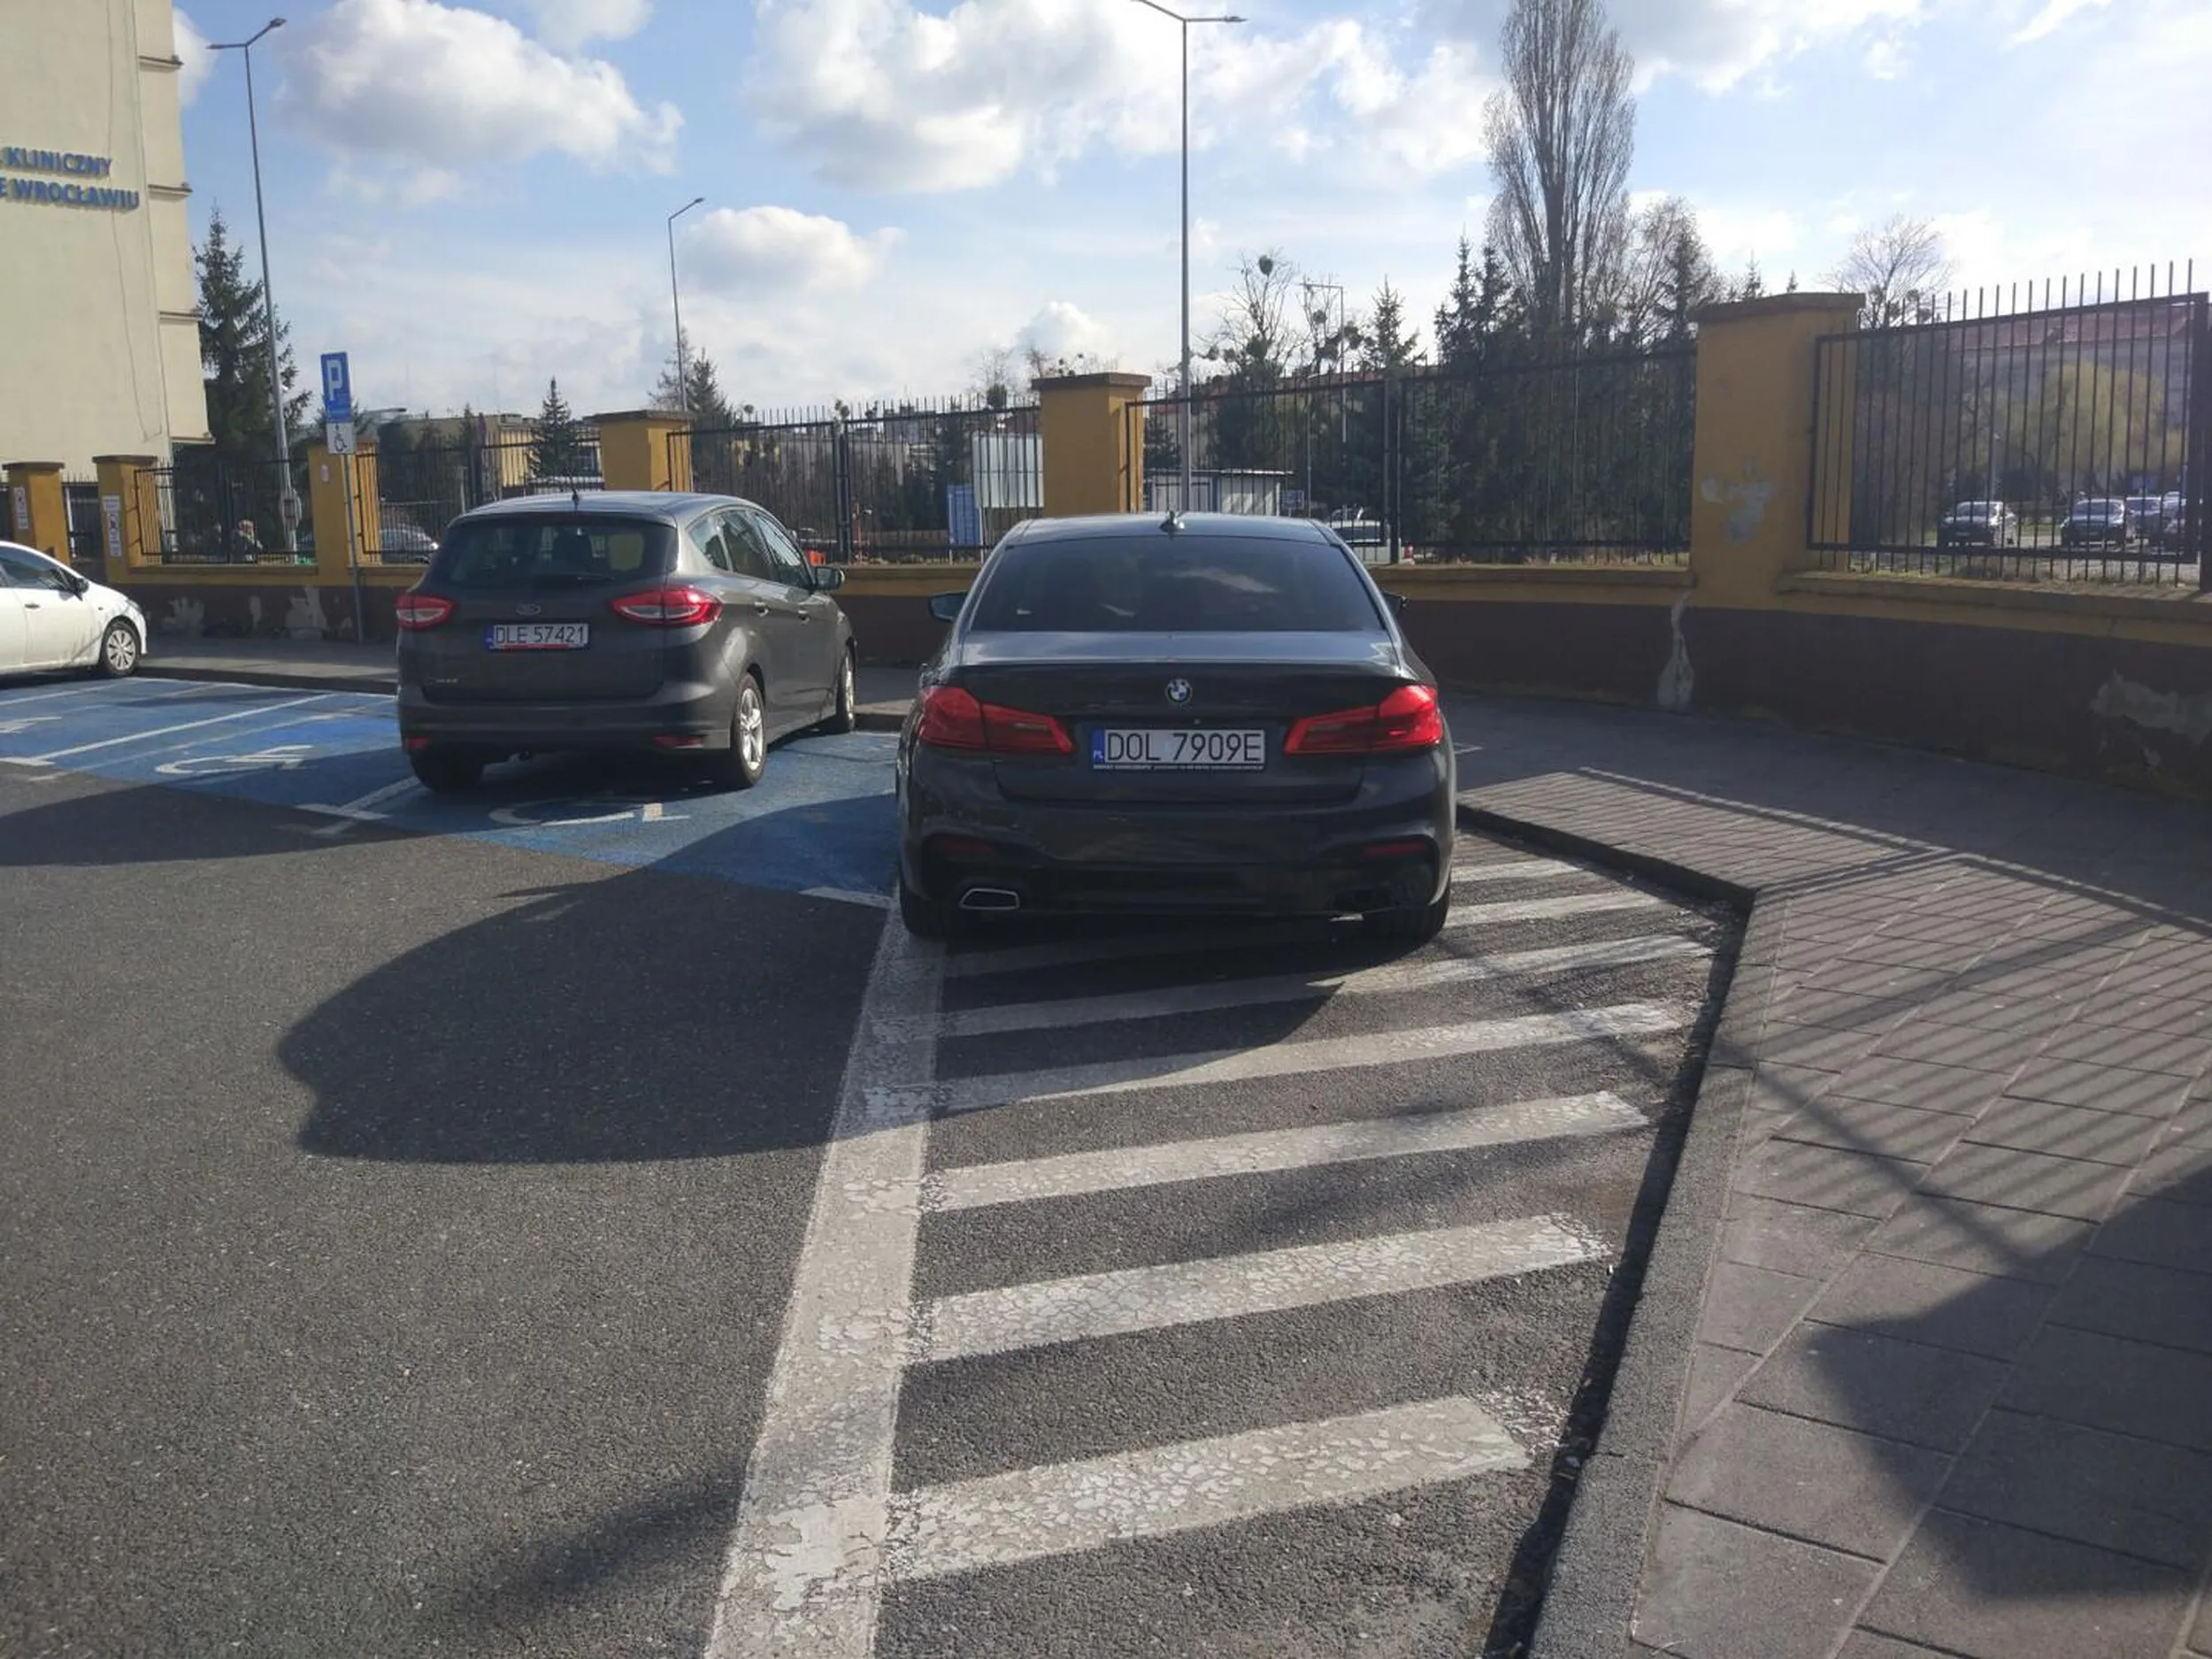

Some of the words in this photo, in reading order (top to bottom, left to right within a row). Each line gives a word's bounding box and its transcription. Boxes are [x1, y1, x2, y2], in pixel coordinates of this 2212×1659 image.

[4, 147, 112, 176] KLINICZNY
[13, 179, 140, 211] WROCŁAWIU
[326, 359, 342, 401] P
[495, 626, 528, 643] DLE
[534, 626, 584, 642] 57421
[1108, 733, 1161, 761] DOL
[1172, 733, 1262, 761] 7909E
